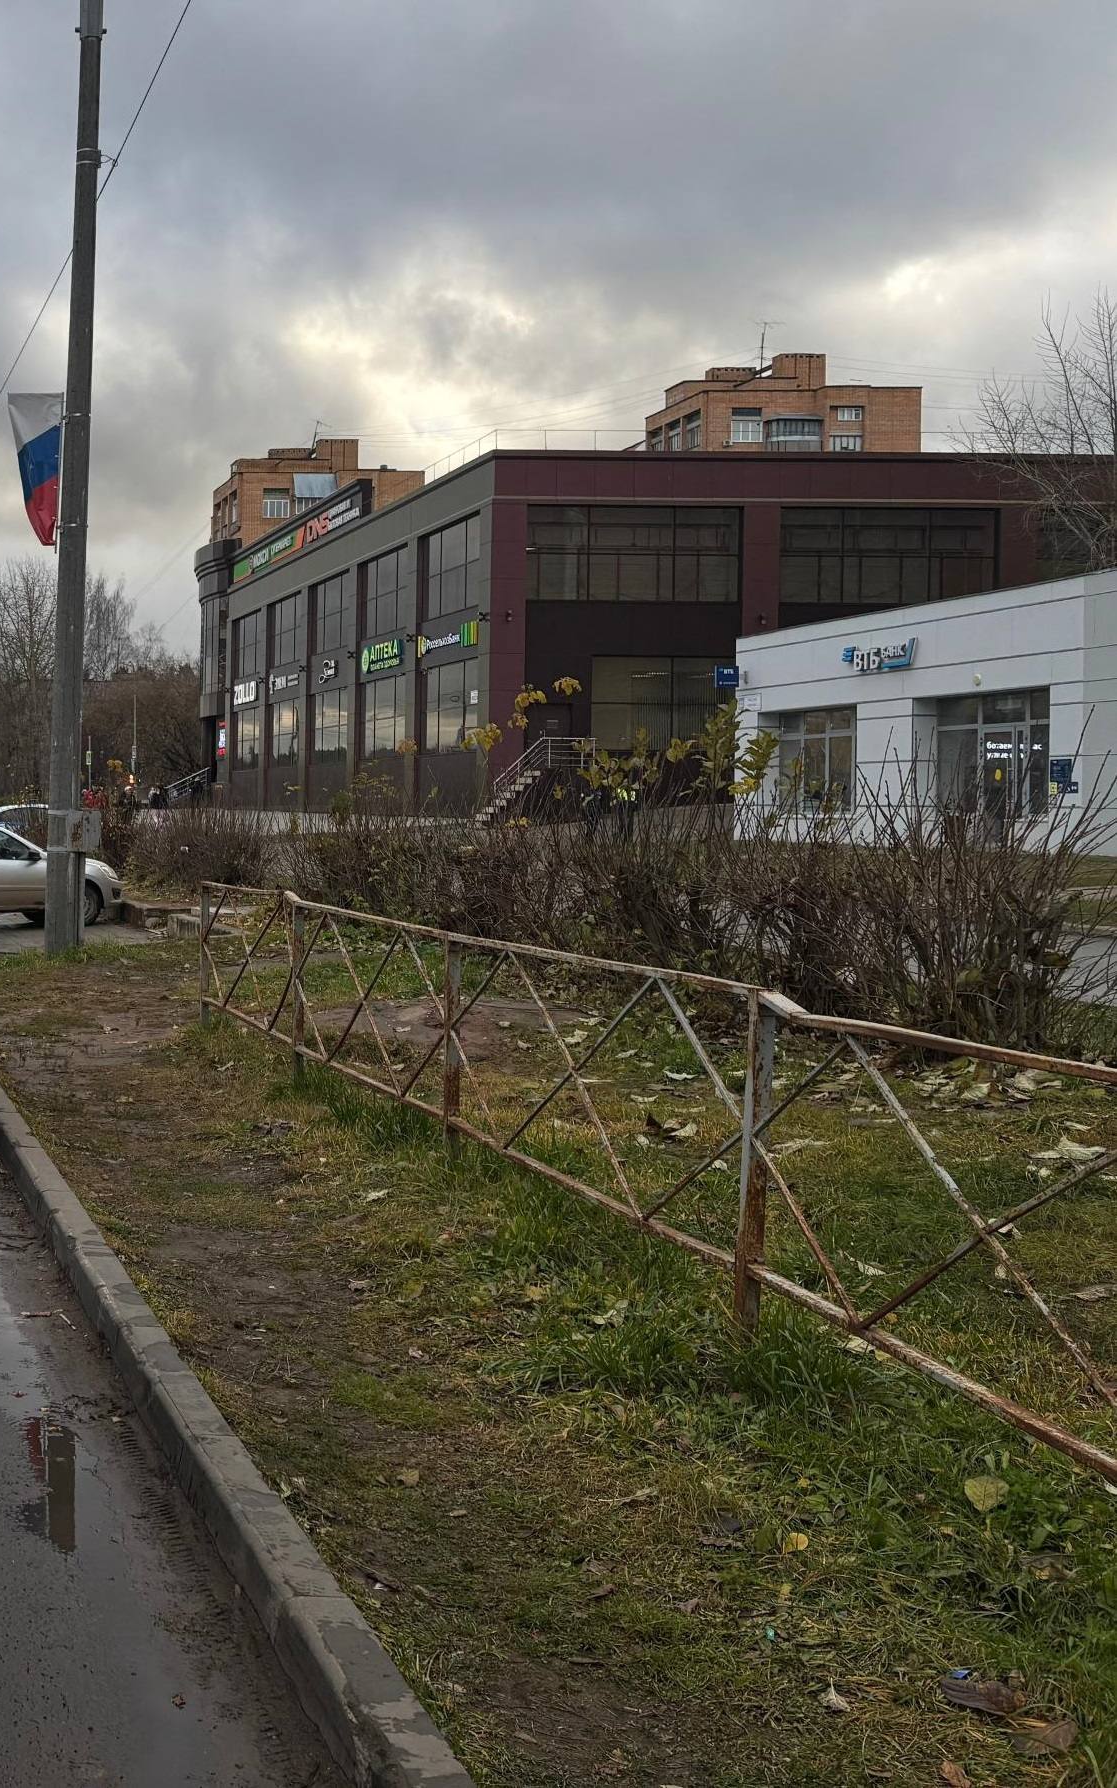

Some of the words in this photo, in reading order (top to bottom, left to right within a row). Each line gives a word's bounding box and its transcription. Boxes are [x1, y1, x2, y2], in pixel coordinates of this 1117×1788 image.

[306, 511, 329, 543] DNS
[370, 639, 399, 662] АПТЕКА
[853, 648, 880, 671] ВТБ
[881, 643, 906, 658] БАНК
[234, 681, 257, 706] ZOLLO
